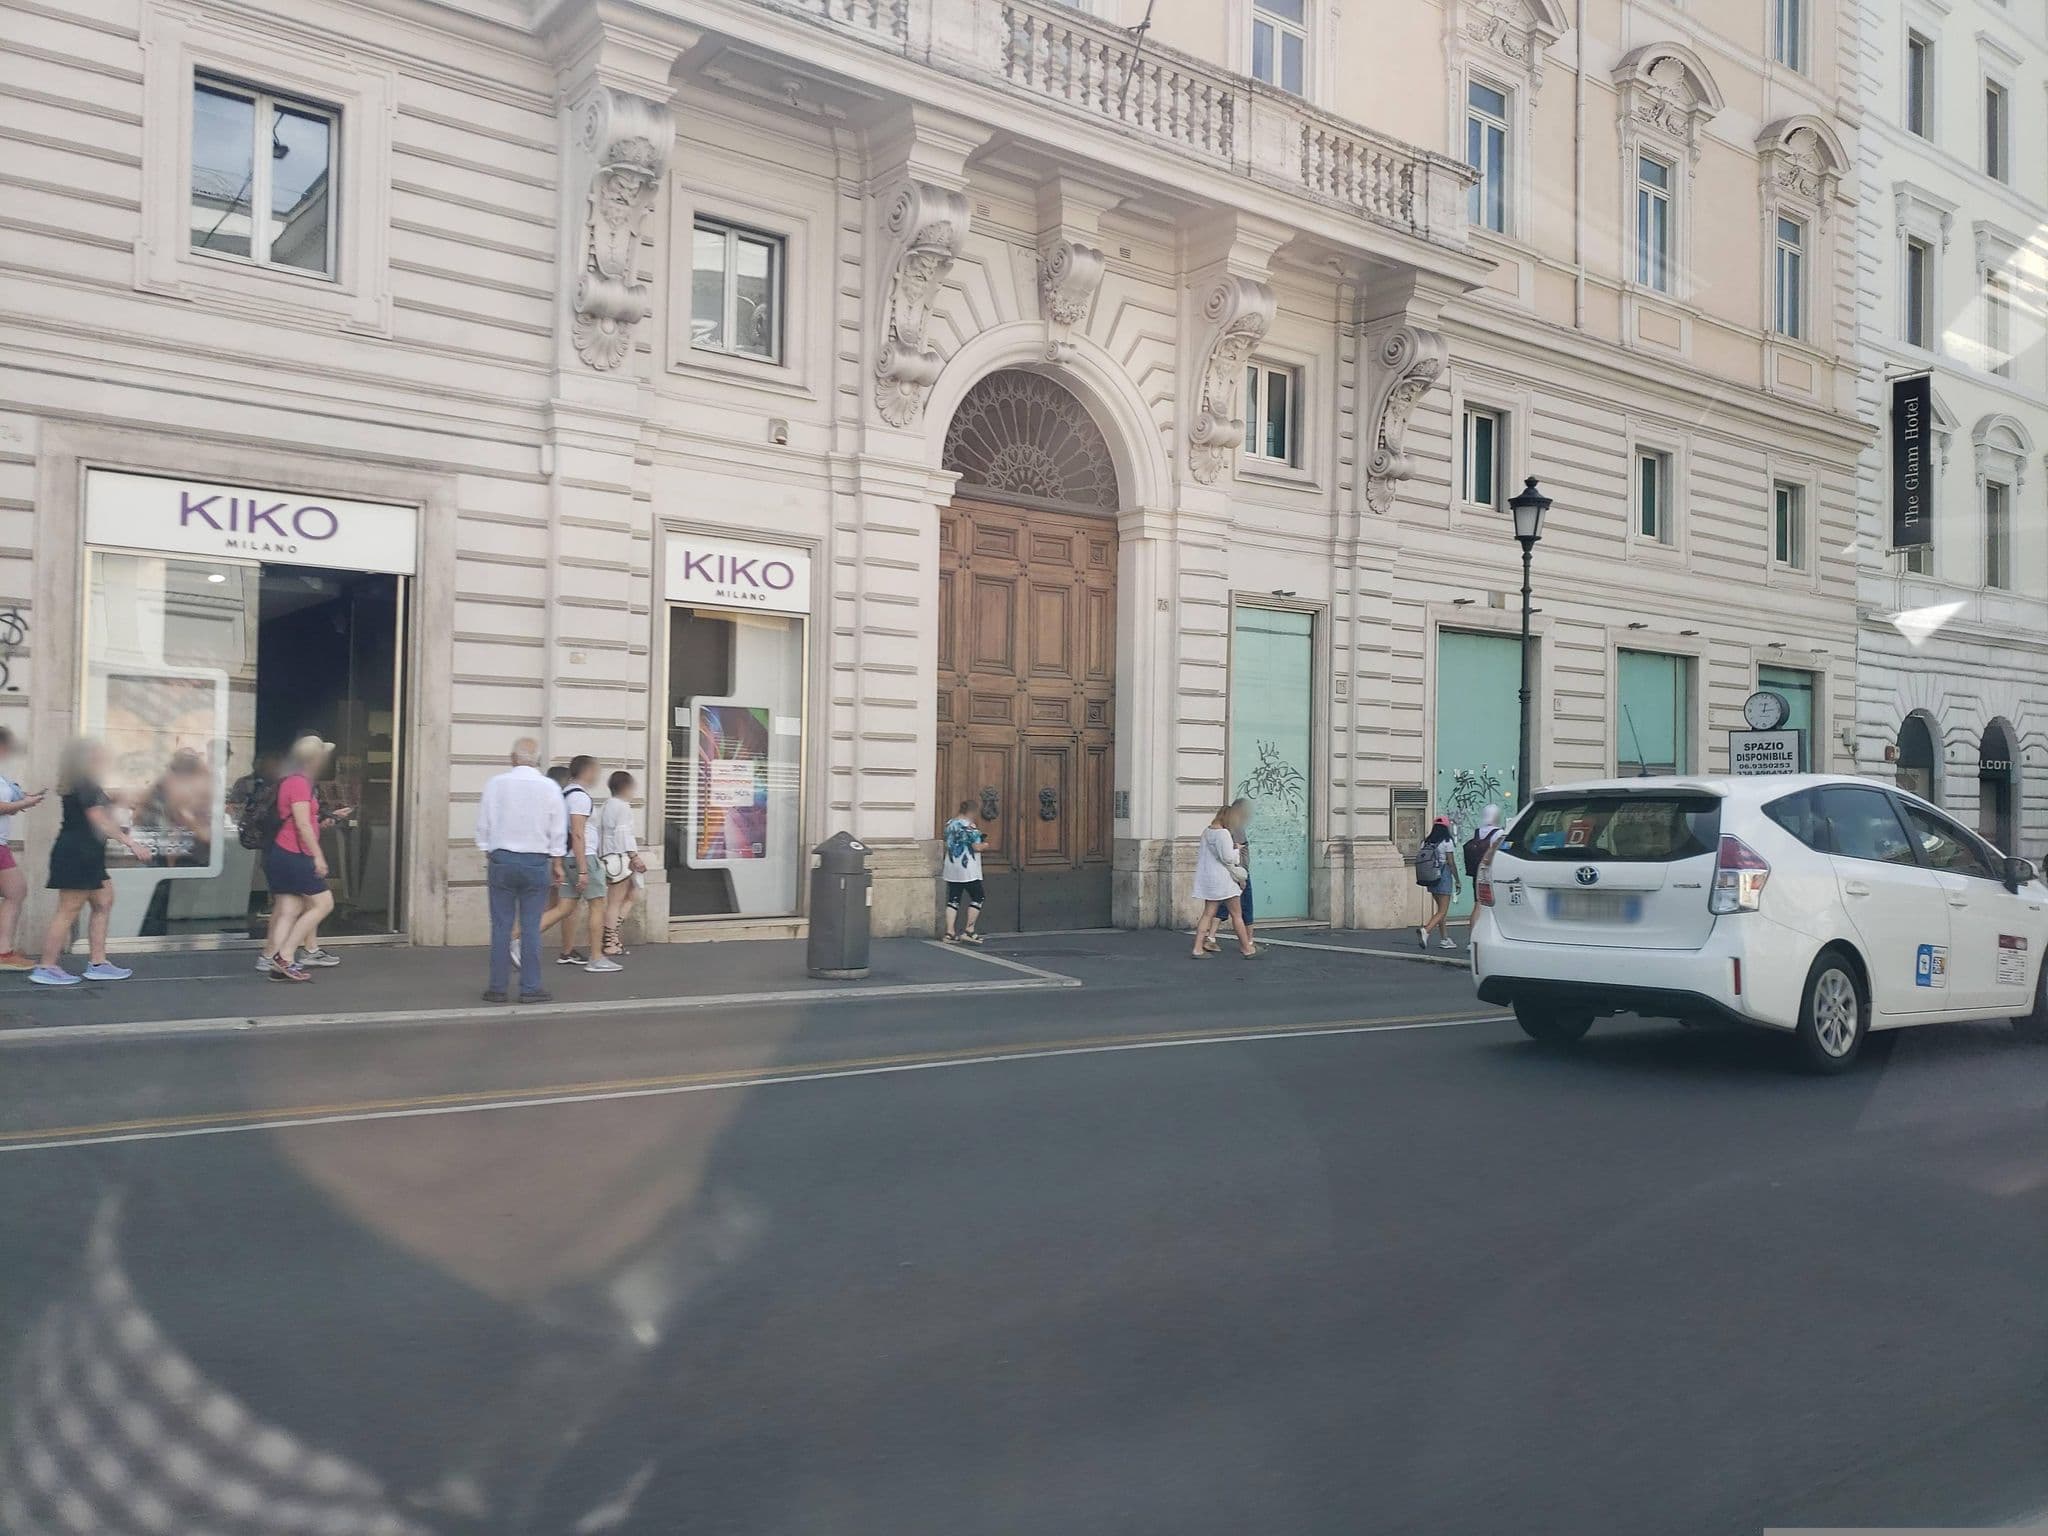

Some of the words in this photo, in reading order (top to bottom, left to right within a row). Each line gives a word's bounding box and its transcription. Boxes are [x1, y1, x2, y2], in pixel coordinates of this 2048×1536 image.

[1904, 397, 1919, 440] Hotel
[1904, 446, 1920, 490] Glam
[180, 491, 338, 540] KIKO
[1904, 495, 1919, 528] The
[225, 539, 298, 553] MILANO
[684, 551, 794, 590] KIKO
[716, 589, 766, 601] MILANO
[1736, 752, 1793, 762] DISPONIBILE
[1743, 742, 1784, 751] SPAZIO
